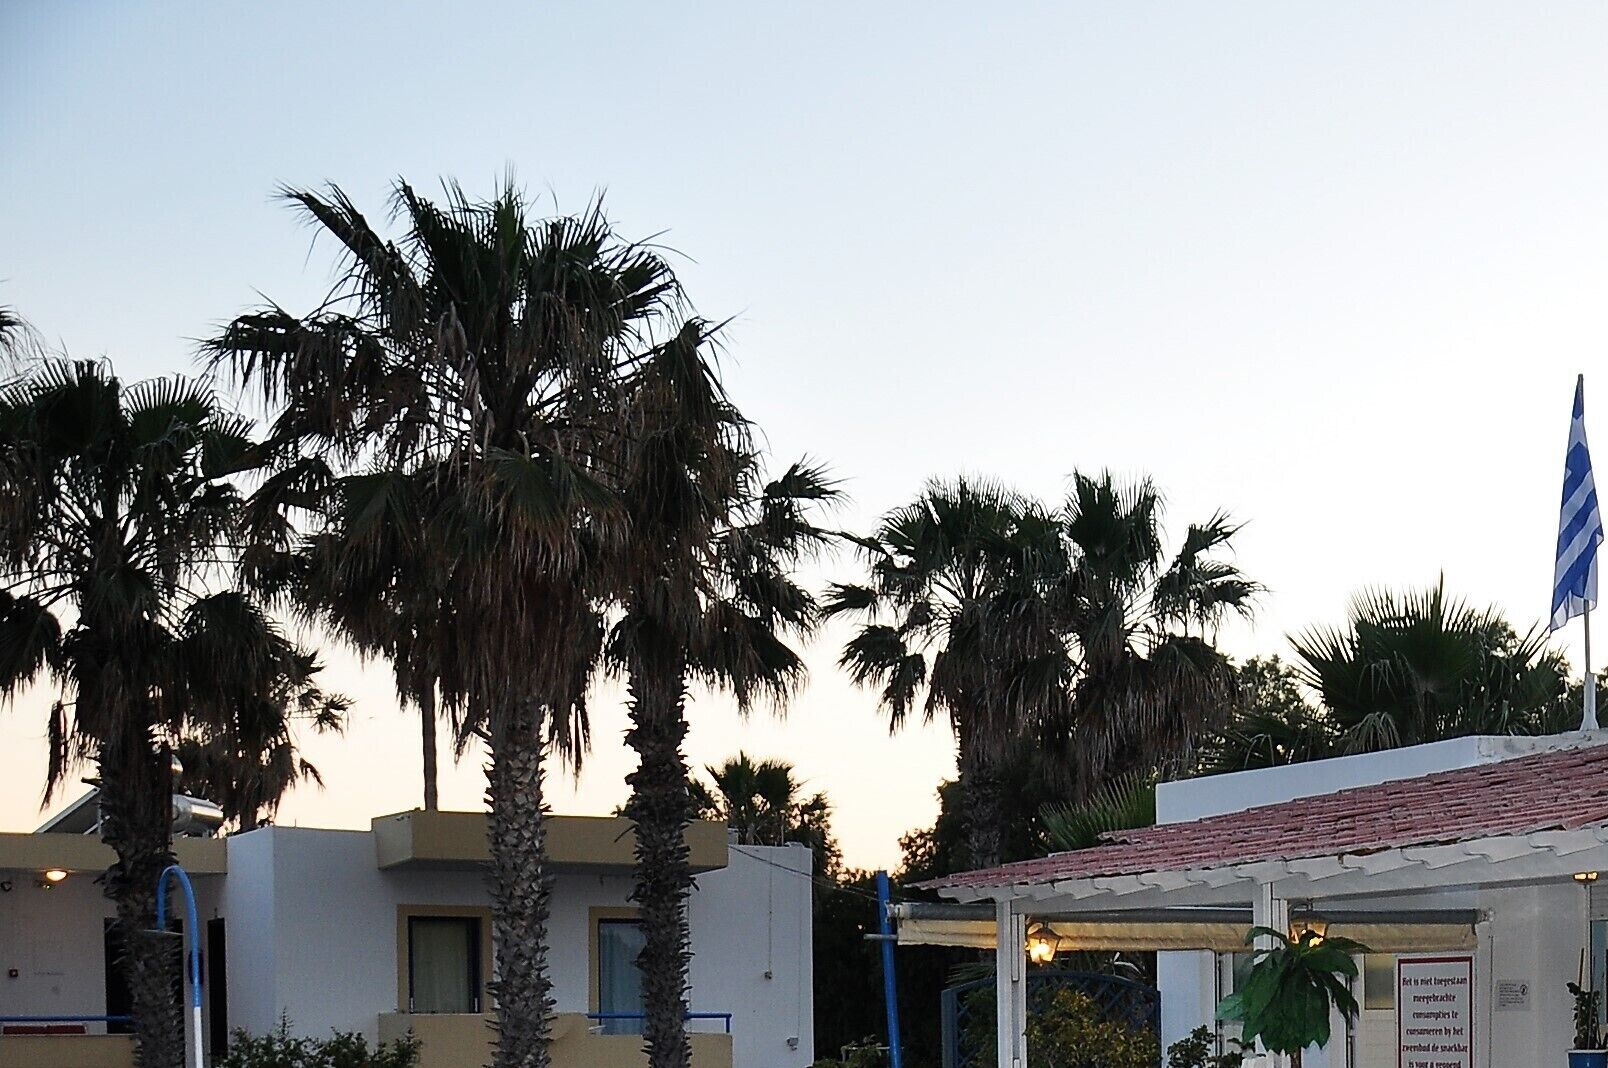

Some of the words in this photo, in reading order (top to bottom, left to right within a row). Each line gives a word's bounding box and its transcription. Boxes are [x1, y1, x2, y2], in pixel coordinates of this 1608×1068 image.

[1434, 976, 1467, 987] toegestaan
[1451, 1010, 1459, 1019] te
[1453, 1027, 1464, 1036] het
[1431, 1043, 1439, 1052] de
[1440, 1043, 1468, 1054] snackbar
